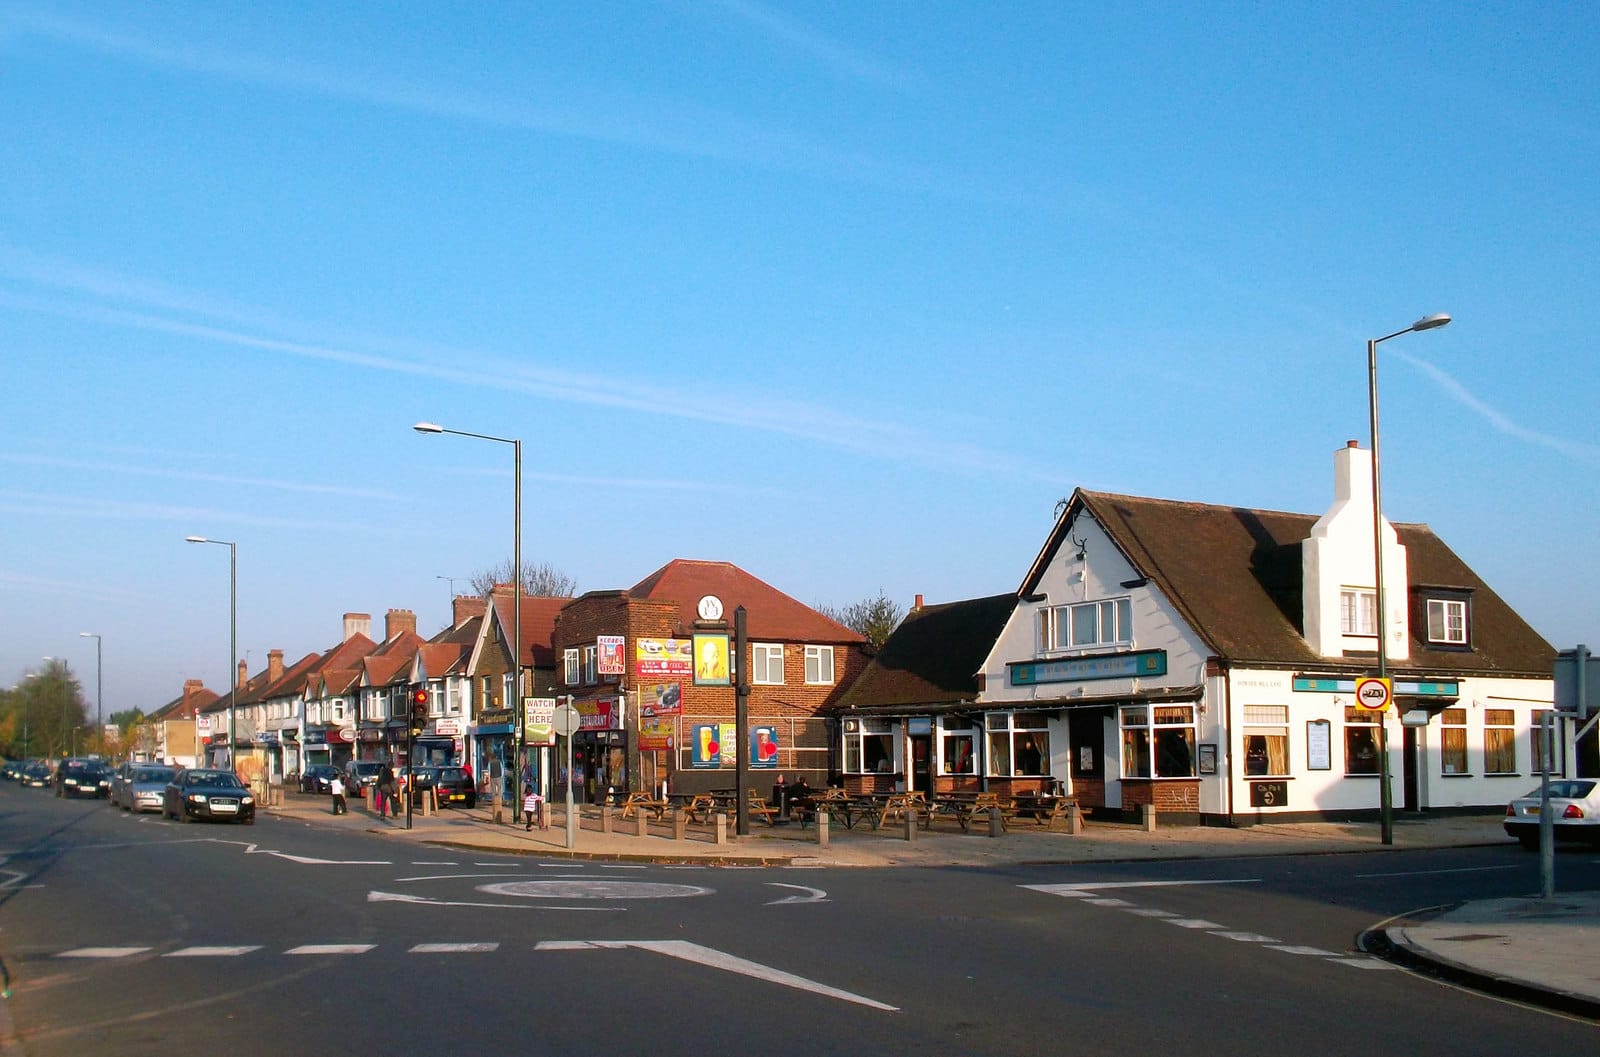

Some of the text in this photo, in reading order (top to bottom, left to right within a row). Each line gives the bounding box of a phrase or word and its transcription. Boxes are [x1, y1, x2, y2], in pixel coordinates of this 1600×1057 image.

[600, 665, 624, 673] OPEN
[526, 699, 554, 708] WATCH
[528, 715, 553, 724] HERE
[579, 714, 607, 727] ESTAURANT
[1257, 784, 1267, 792] Ca
